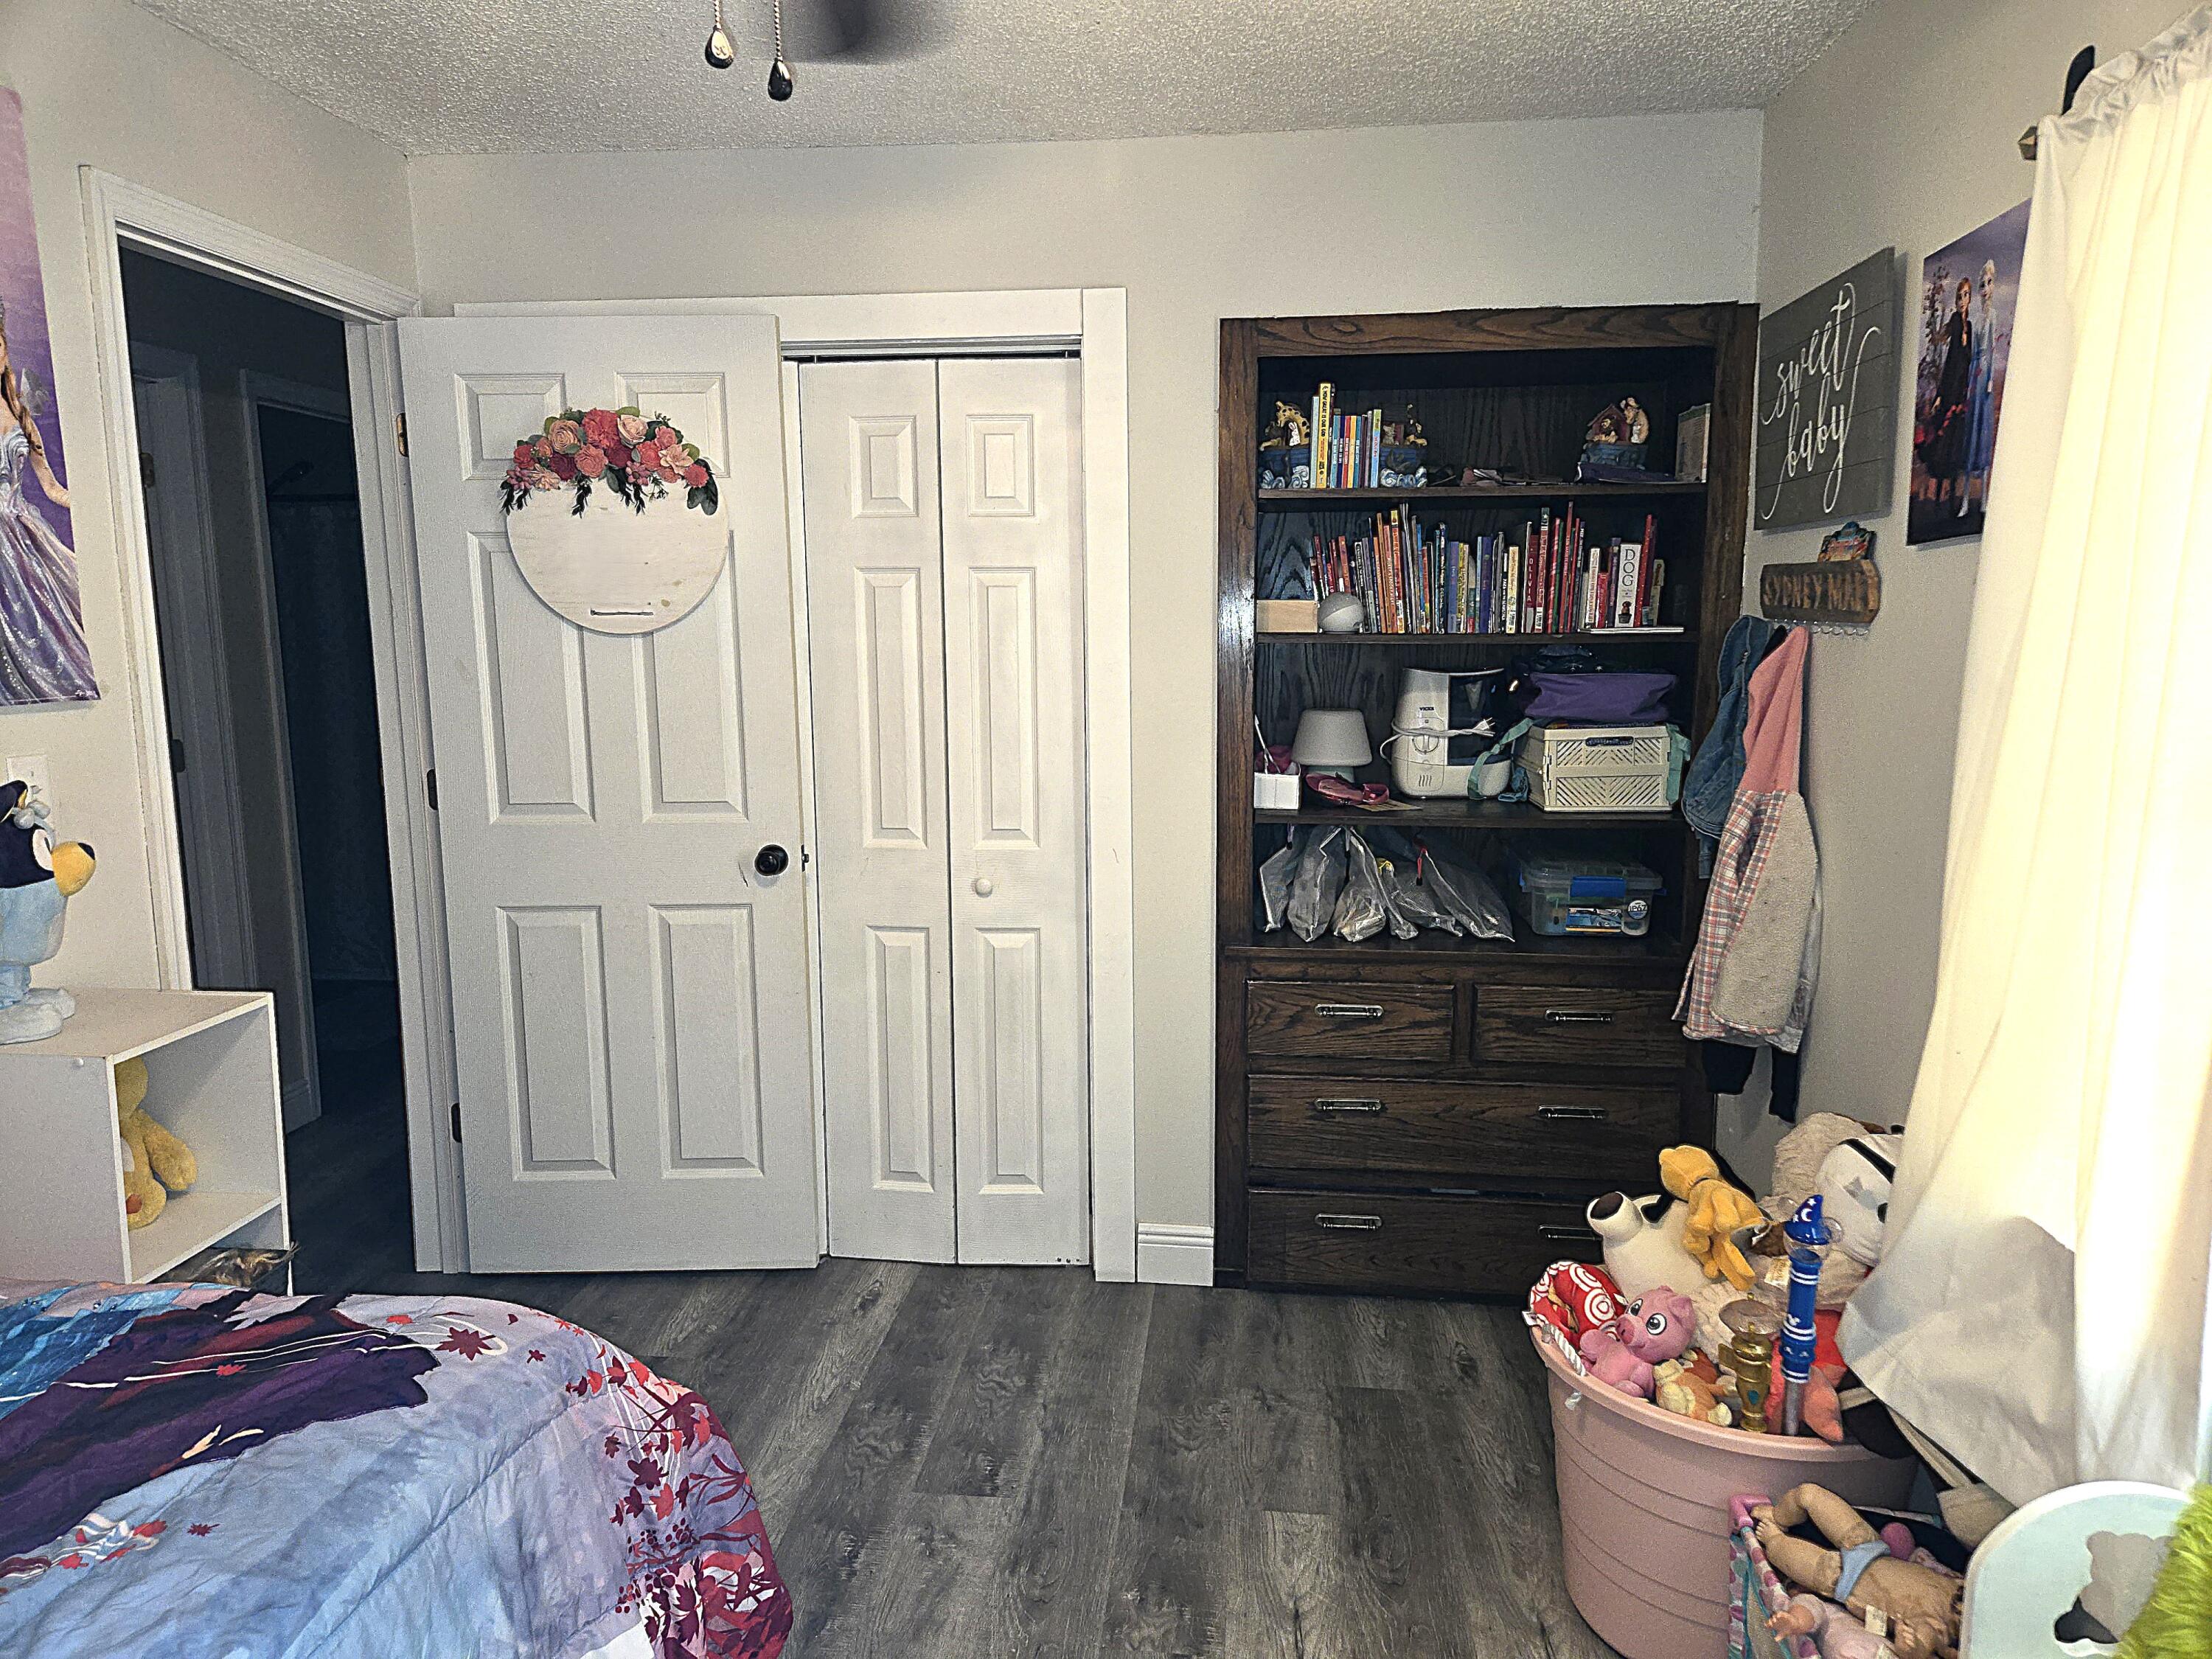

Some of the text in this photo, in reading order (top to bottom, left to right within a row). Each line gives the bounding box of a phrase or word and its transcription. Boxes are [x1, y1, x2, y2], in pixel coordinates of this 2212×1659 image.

[1760, 282, 1856, 425] sweet
[1760, 327, 1881, 520] baby
[1622, 549, 1635, 587] DOG
[1762, 573, 1823, 610] SYDNEY
